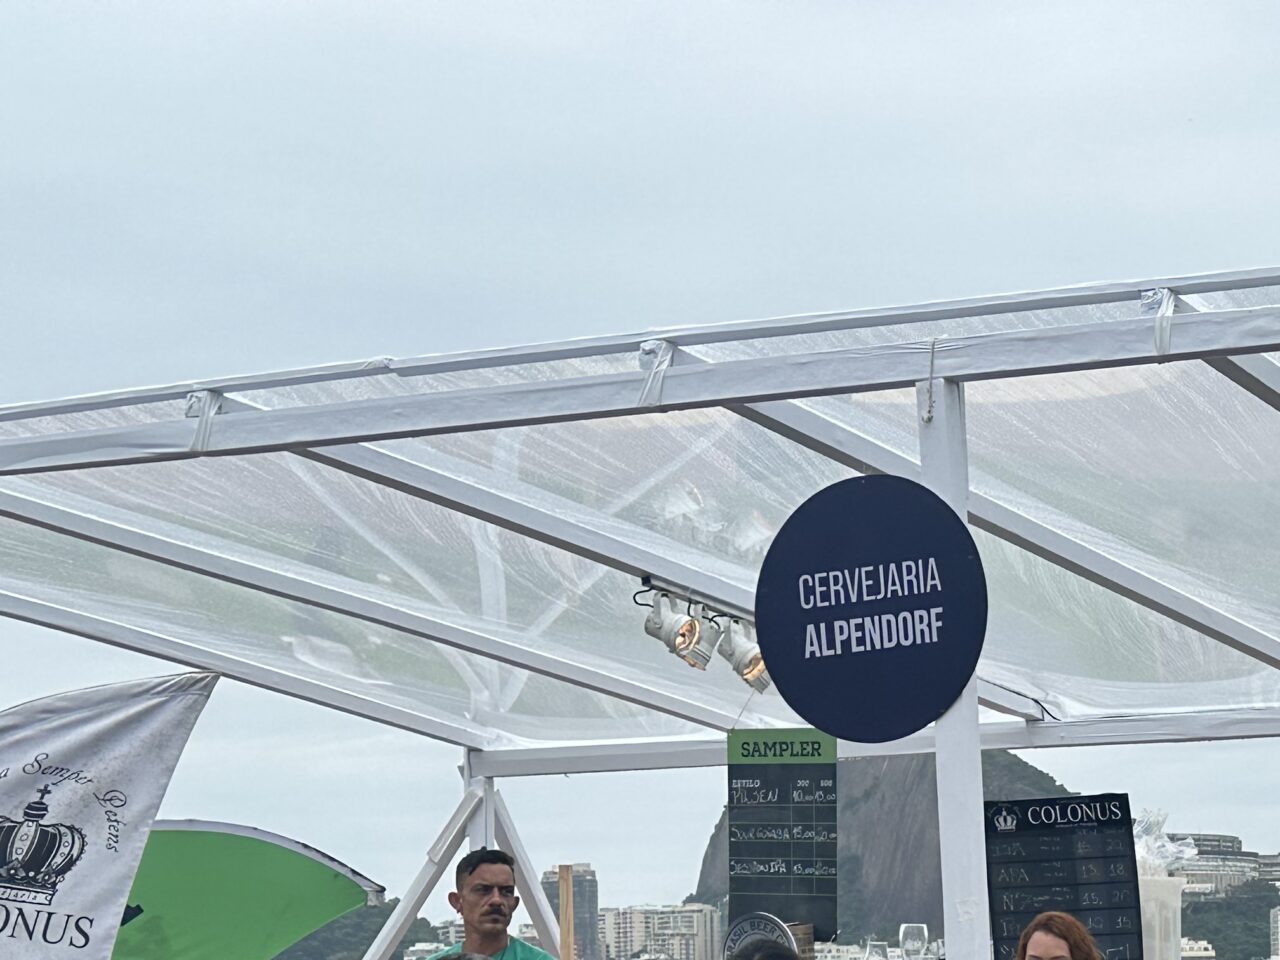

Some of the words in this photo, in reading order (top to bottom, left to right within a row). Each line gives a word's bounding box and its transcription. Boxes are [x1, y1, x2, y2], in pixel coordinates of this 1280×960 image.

[798, 557, 942, 610] CERVEJARIA
[804, 607, 943, 660] ALPENDORF
[741, 741, 822, 757] SAMPLER
[1028, 802, 1122, 824] COLONUS
